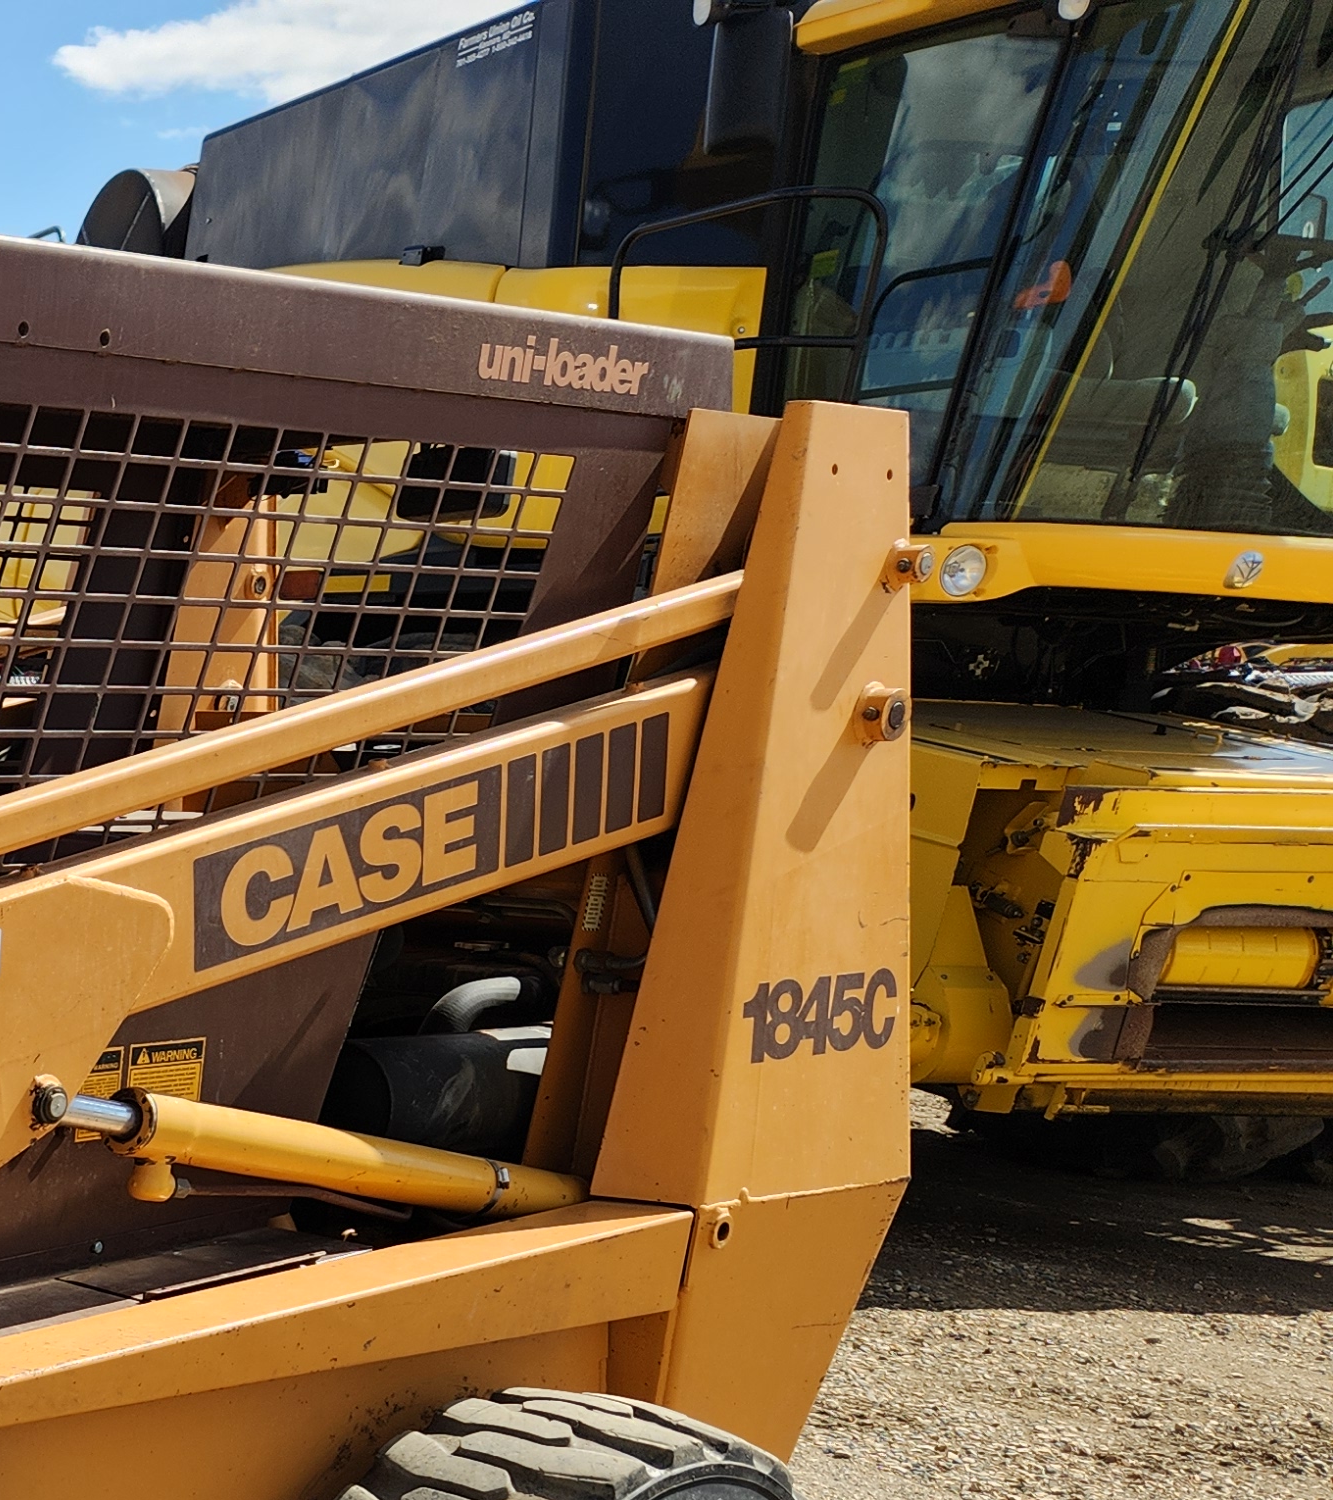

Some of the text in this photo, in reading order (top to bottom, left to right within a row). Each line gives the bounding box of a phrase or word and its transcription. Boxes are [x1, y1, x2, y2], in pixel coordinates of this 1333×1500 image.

[457, 31, 489, 51] Farmers
[488, 21, 510, 39] Union
[478, 335, 649, 396] uni-loader
[221, 780, 479, 947] CASE
[743, 967, 898, 1064] 1845C
[151, 1047, 199, 1063] WARNING
